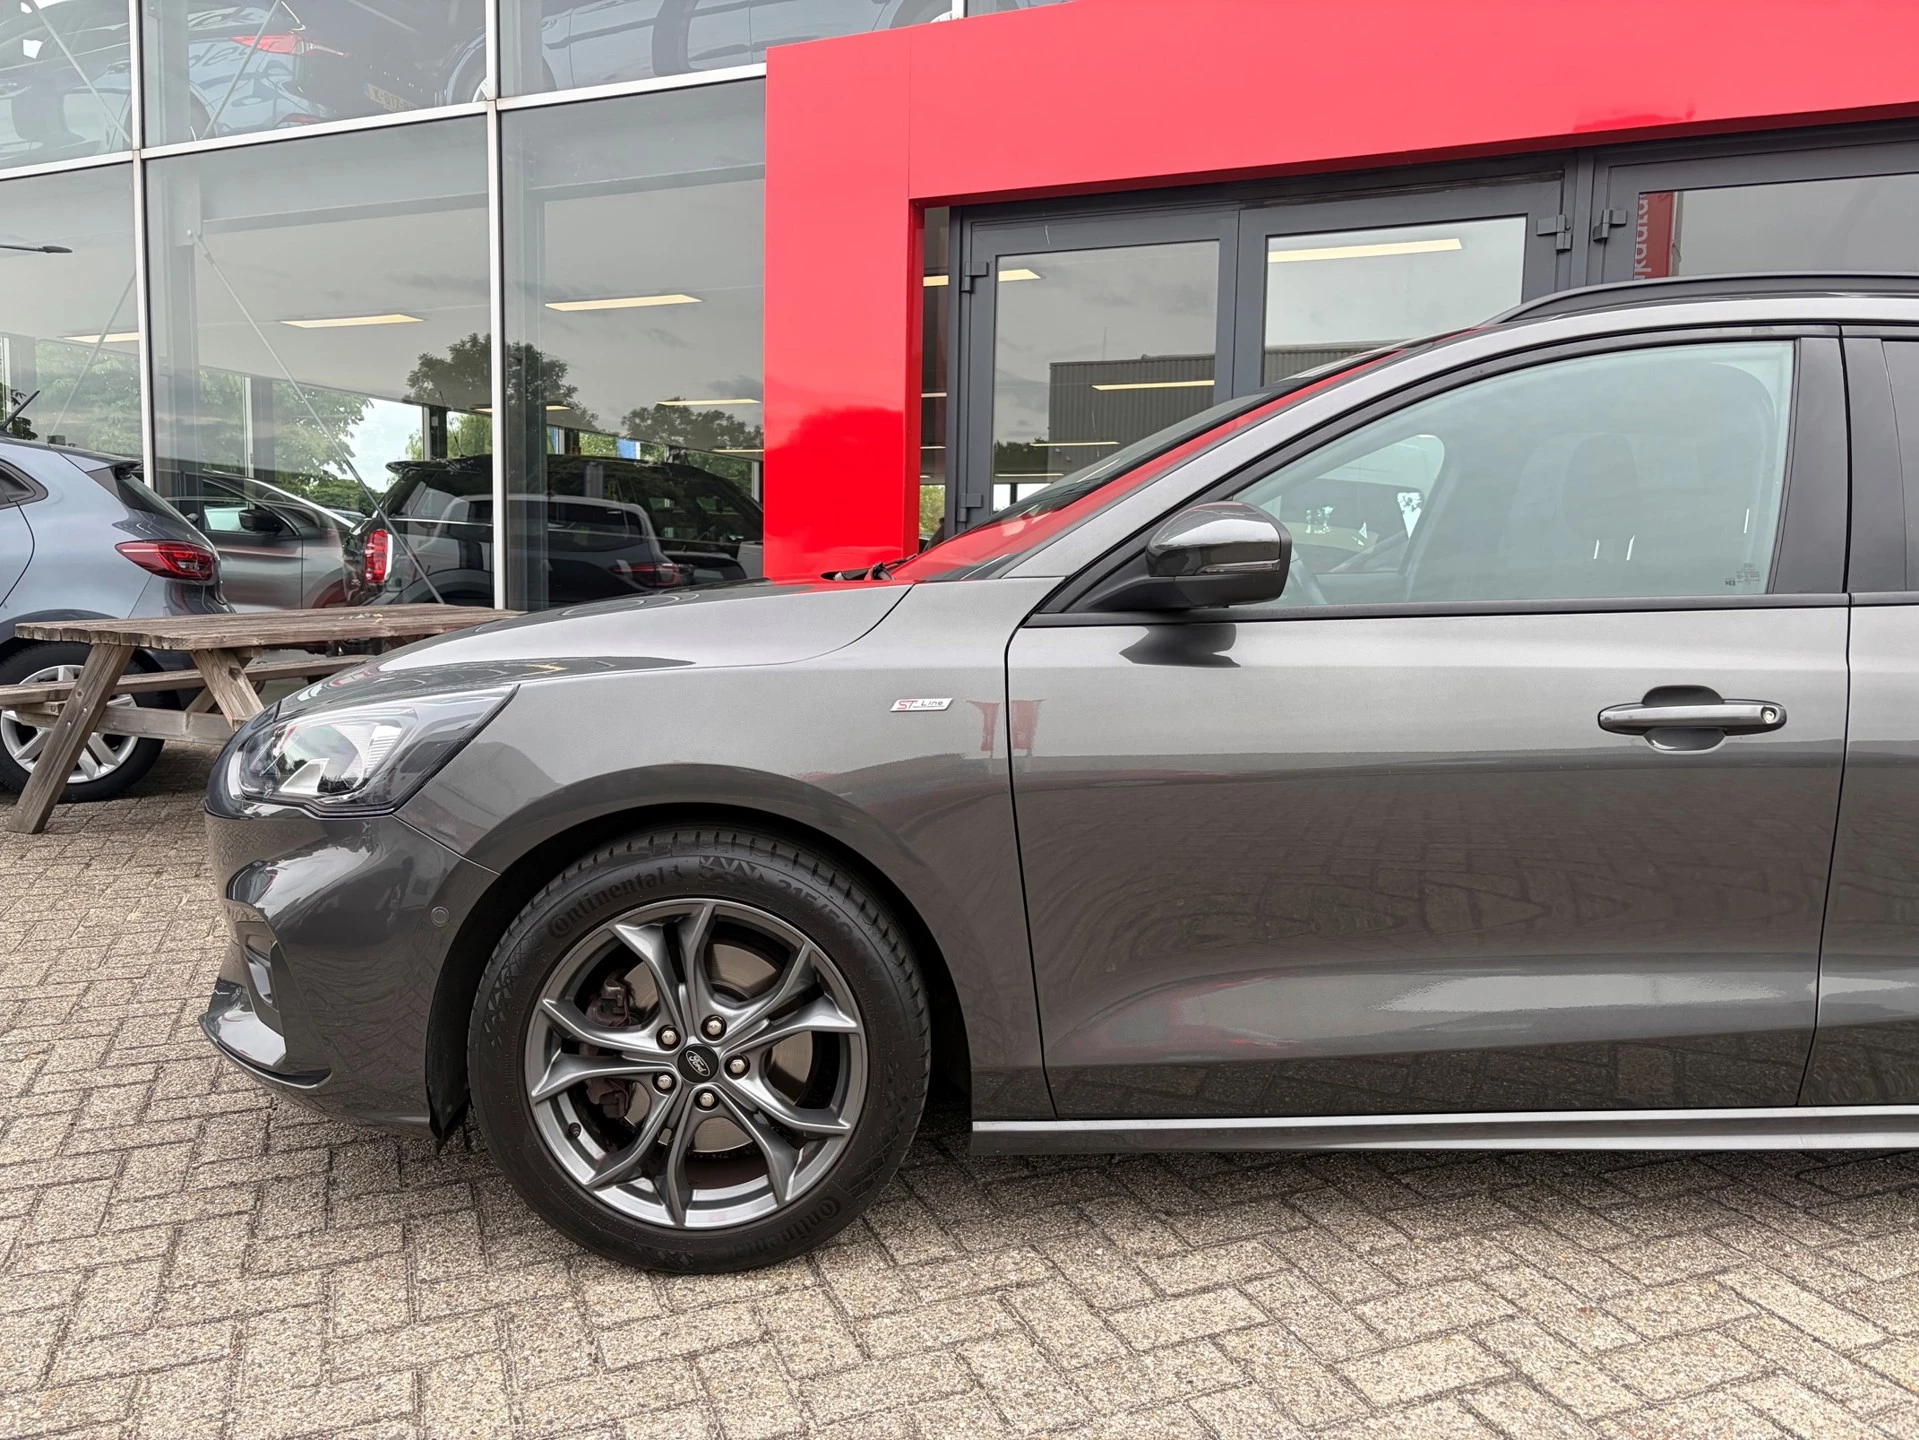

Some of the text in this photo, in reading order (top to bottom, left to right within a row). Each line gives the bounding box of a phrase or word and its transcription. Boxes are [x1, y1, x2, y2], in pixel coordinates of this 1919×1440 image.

[897, 700, 918, 709] ST
[548, 866, 664, 940] Continental
[689, 1055, 707, 1072] Ford
